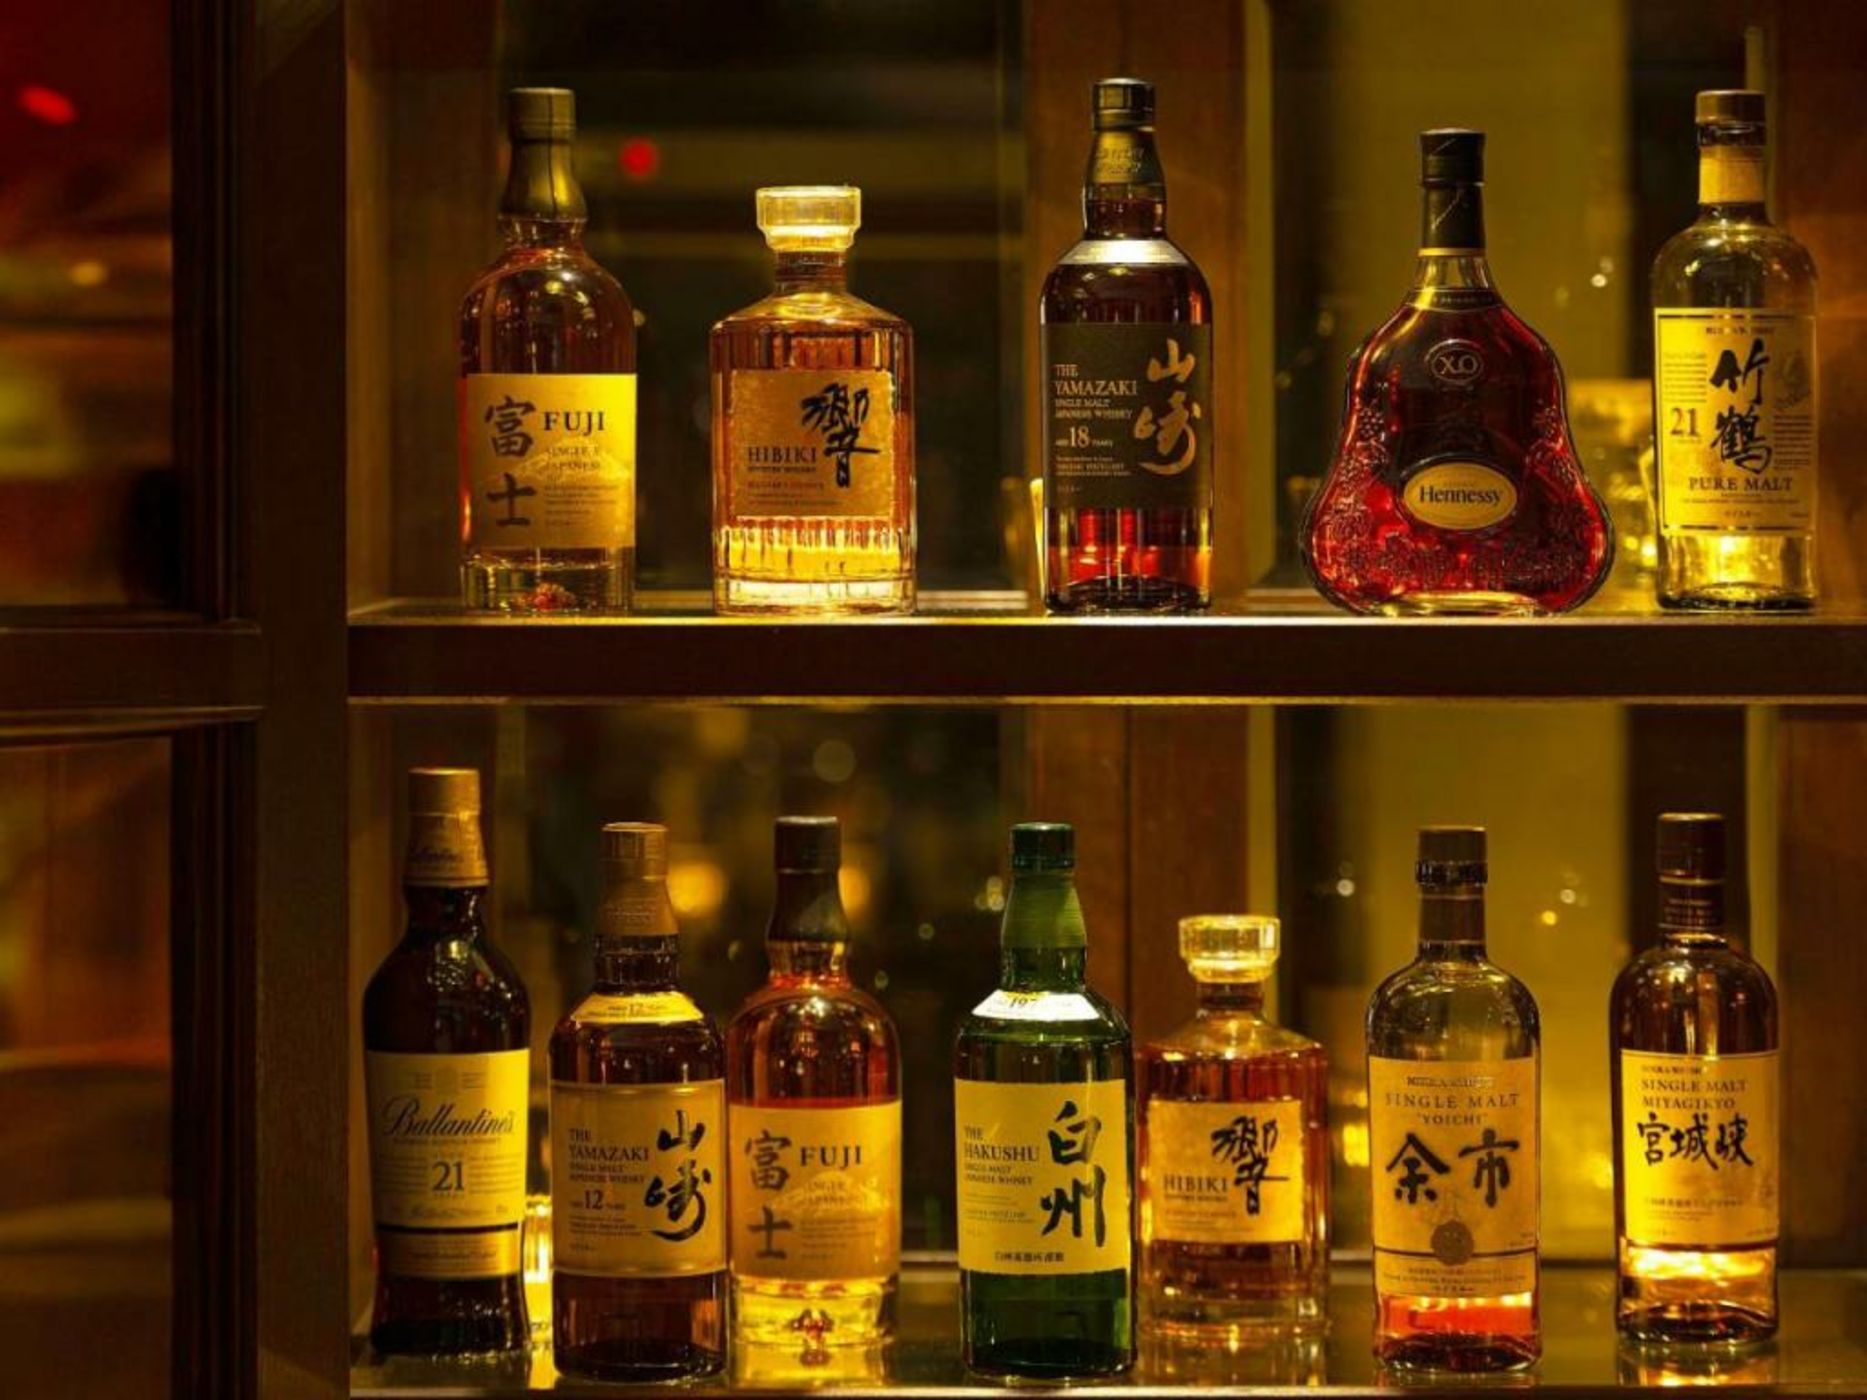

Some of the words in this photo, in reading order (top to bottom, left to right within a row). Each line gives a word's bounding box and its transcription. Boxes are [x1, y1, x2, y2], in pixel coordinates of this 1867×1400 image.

[1055, 364, 1078, 376] THE
[1055, 381, 1137, 395] YAMAZAKI
[1134, 338, 1201, 475] 山崎
[544, 411, 606, 436] FUJI
[1670, 408, 1699, 436] 21
[1070, 426, 1090, 448] 18
[484, 395, 537, 527] 富士
[748, 446, 816, 463] HIBIKI
[1689, 477, 1738, 491] PURE
[1743, 477, 1794, 491] MALT
[1419, 485, 1503, 507] Hennessy
[1642, 1080, 1700, 1092] SINGLE
[1706, 1080, 1748, 1092] MALT
[1386, 1094, 1457, 1108] SINGLE
[1469, 1093, 1520, 1108] MALT
[1642, 1097, 1736, 1109] MIYAGIKYO
[569, 1128, 591, 1140] THE
[964, 1126, 985, 1140] THE
[569, 1145, 648, 1160] YAMAZAKI
[800, 1145, 861, 1170] FUJI
[964, 1143, 1040, 1161] HAKUSHU
[432, 1161, 465, 1191] 21
[644, 1109, 712, 1242] 山崎
[1040, 1100, 1107, 1248] 白州
[1386, 1128, 1520, 1208] 余市
[1164, 1175, 1227, 1193] HIBIKI
[584, 1190, 604, 1209] 12
[745, 1129, 792, 1260] 富士
